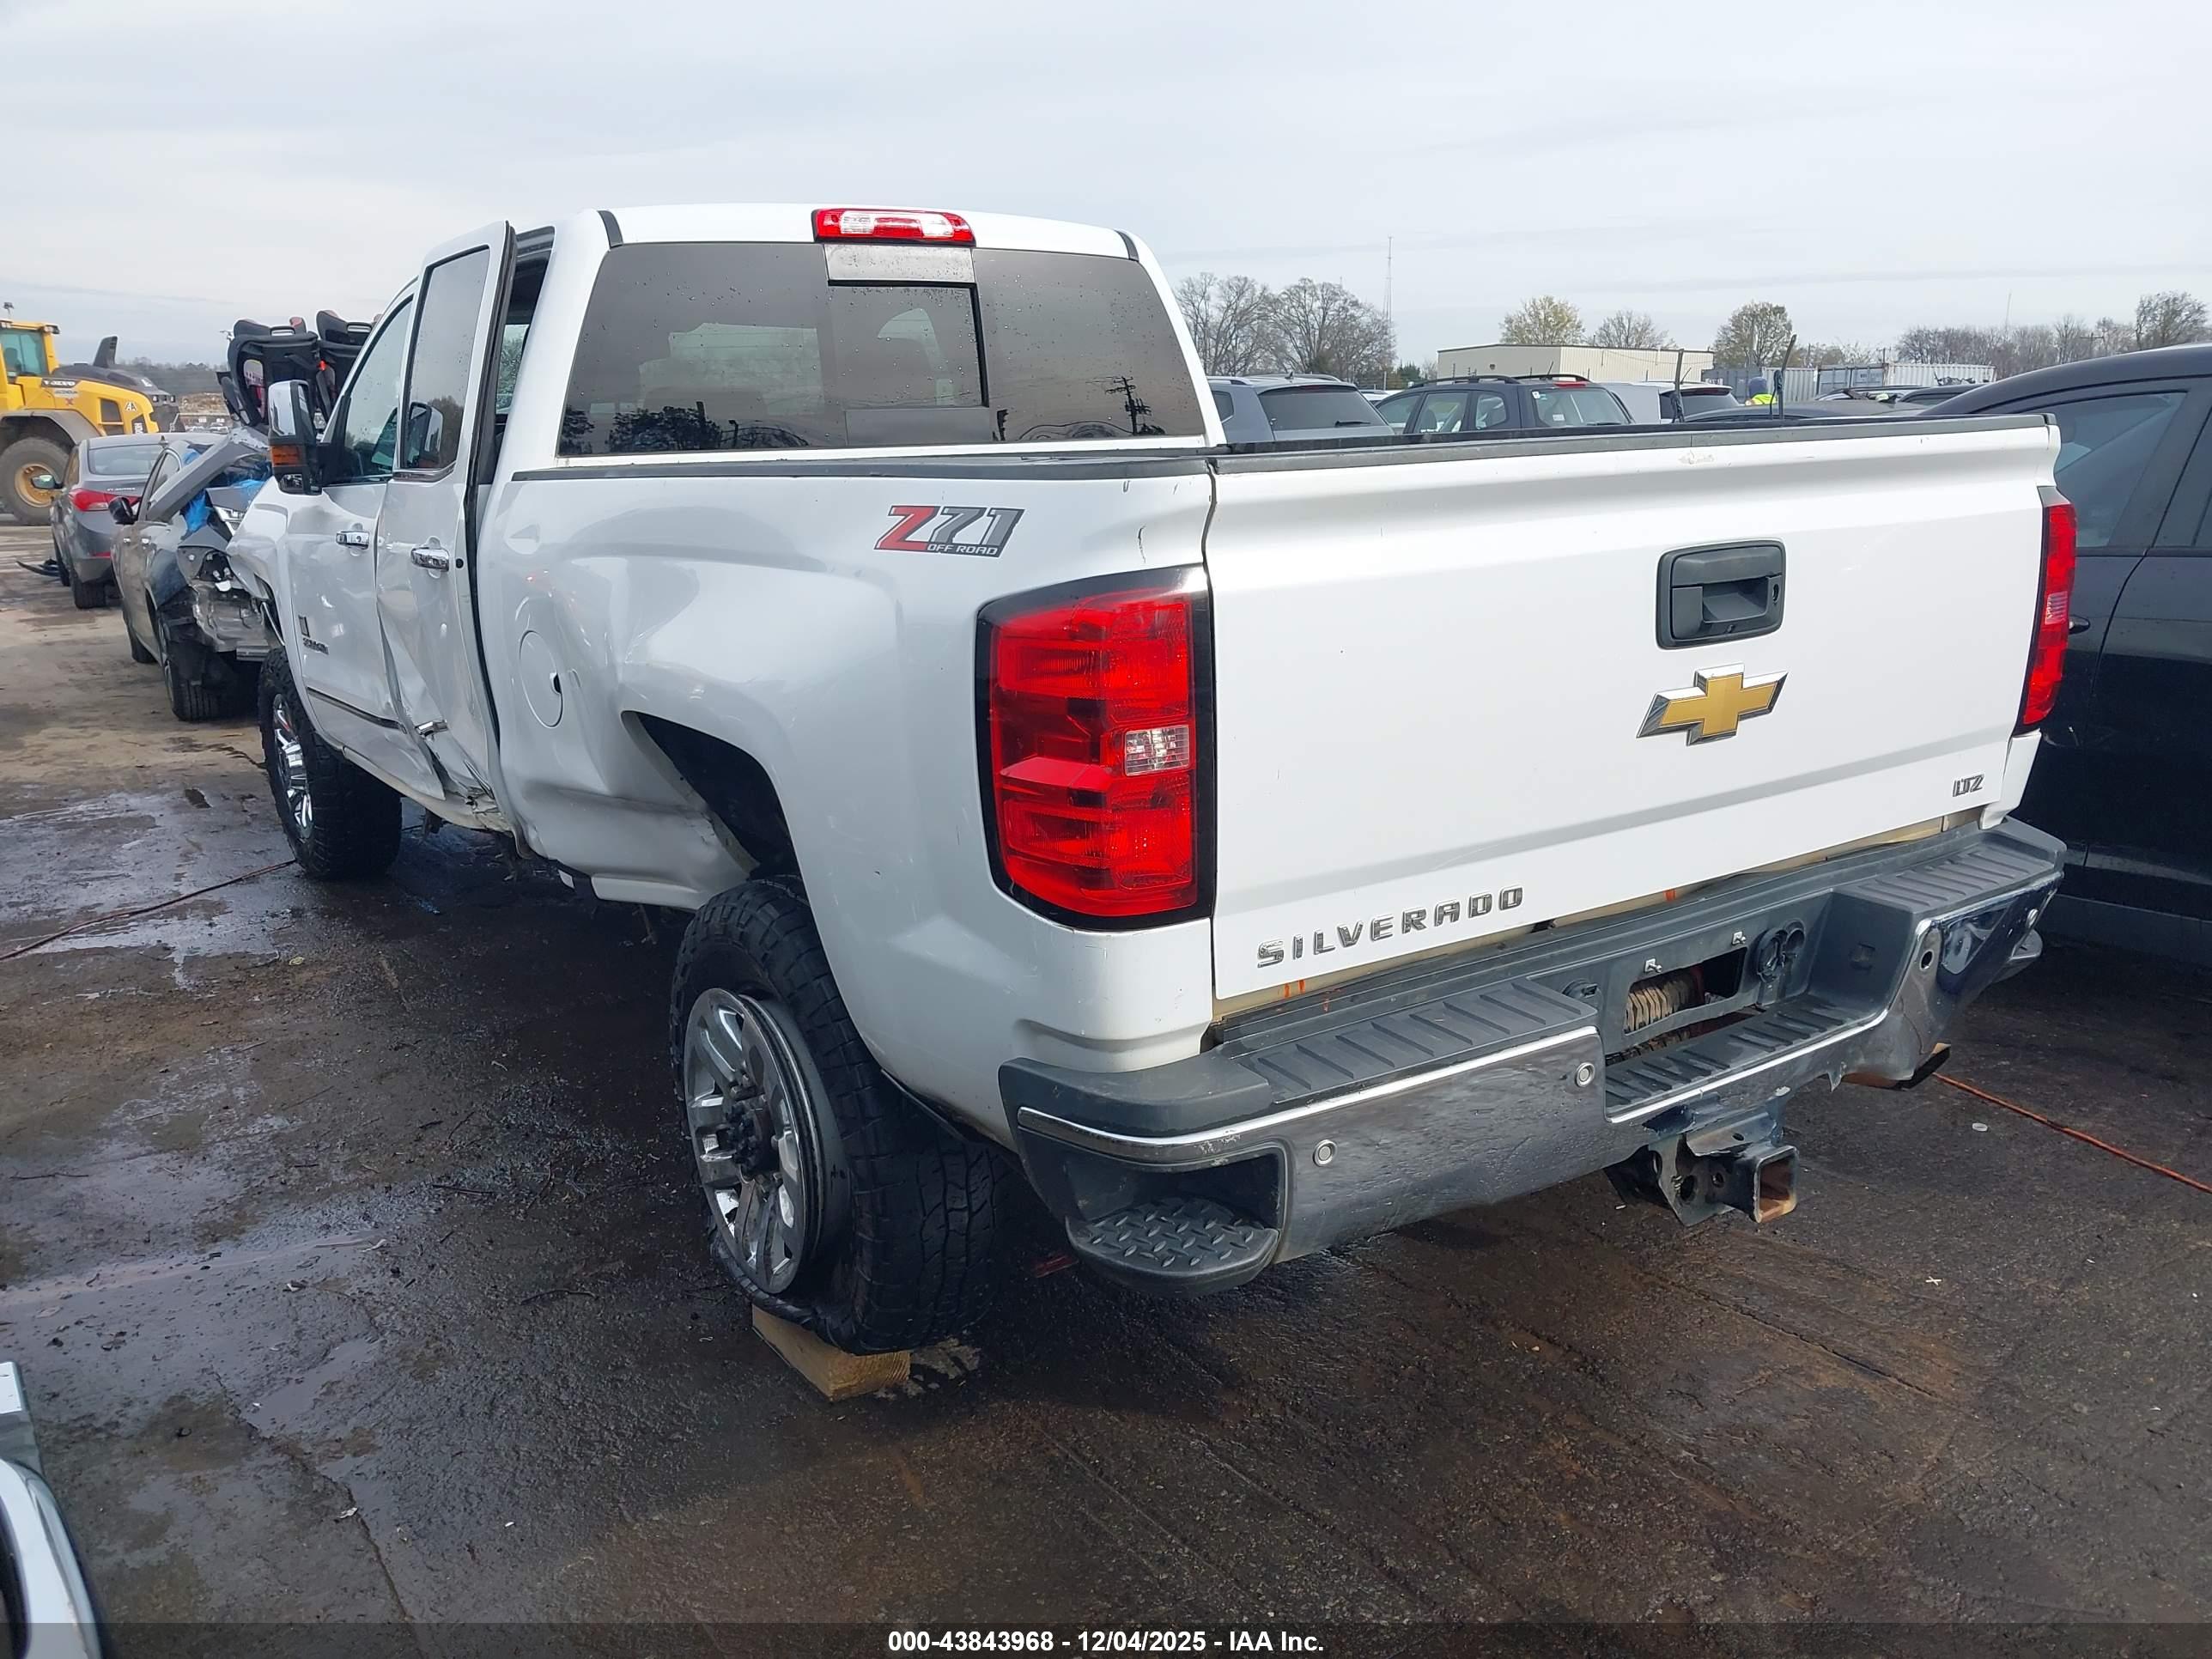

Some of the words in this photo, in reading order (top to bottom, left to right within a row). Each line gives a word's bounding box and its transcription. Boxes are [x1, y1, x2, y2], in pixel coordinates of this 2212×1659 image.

[874, 505, 1025, 550] Z71
[927, 544, 954, 552] OFF
[956, 545, 999, 556] ROAD
[1952, 773, 1984, 797] LTZ
[1256, 885, 1524, 968] SILVERADO
